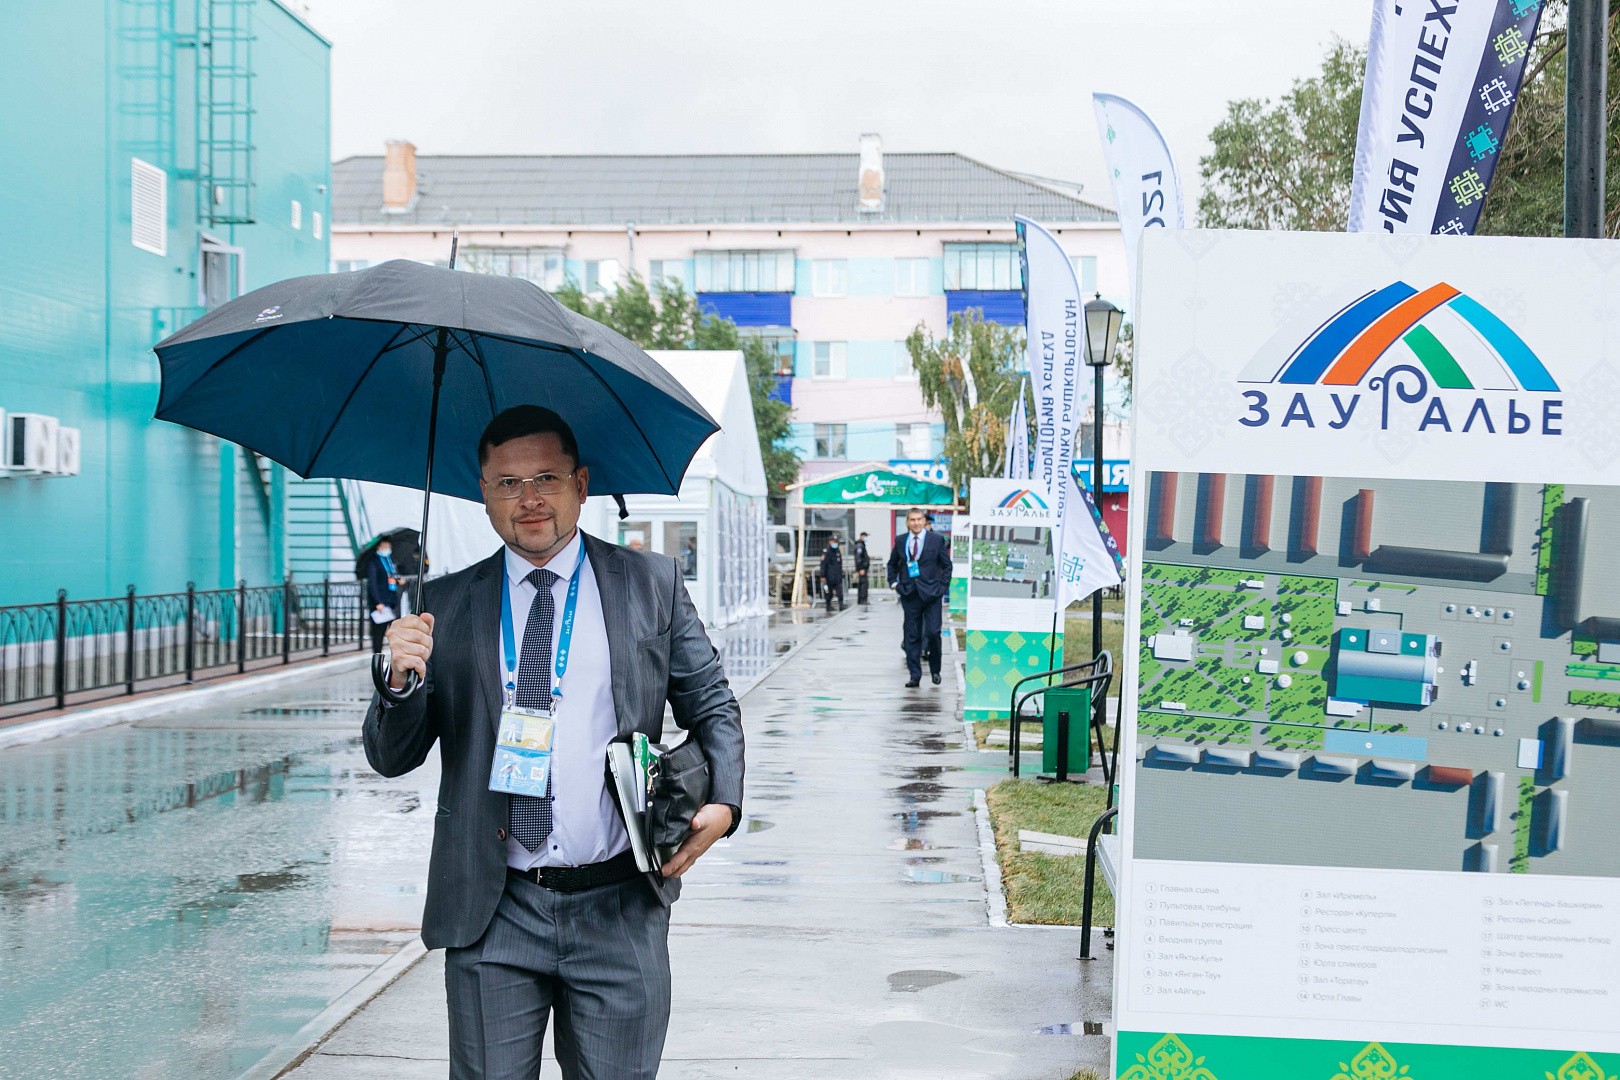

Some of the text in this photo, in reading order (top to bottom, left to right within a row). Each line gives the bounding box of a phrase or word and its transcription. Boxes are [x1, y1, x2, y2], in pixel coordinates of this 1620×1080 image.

[1238, 364, 1563, 435] ЗАУРАЛЬЕ
[884, 486, 906, 495] FEST
[990, 504, 1050, 518] ЗАУРАЛЬЕ
[1160, 885, 1193, 893] Главная
[1195, 887, 1219, 895] сцена
[1316, 891, 1330, 899] Зал
[1498, 897, 1513, 906] Зал
[1207, 904, 1241, 913] трибуны
[1315, 908, 1353, 918] Ресторан
[1159, 918, 1199, 927] Павильон
[1202, 921, 1253, 930] регистрации
[1497, 915, 1535, 924] Ресторан
[1158, 935, 1192, 945] Входная
[1195, 938, 1222, 946] группа
[1314, 942, 1334, 950] Зона
[1158, 952, 1173, 960] Зал
[1313, 959, 1336, 968] Юрта
[1338, 961, 1377, 969] спикеров
[1158, 969, 1172, 977] Зал
[1313, 976, 1328, 984] Зал
[1157, 986, 1172, 994] Зал
[1312, 993, 1334, 1002] Юрта
[1494, 1000, 1509, 1009] WC
